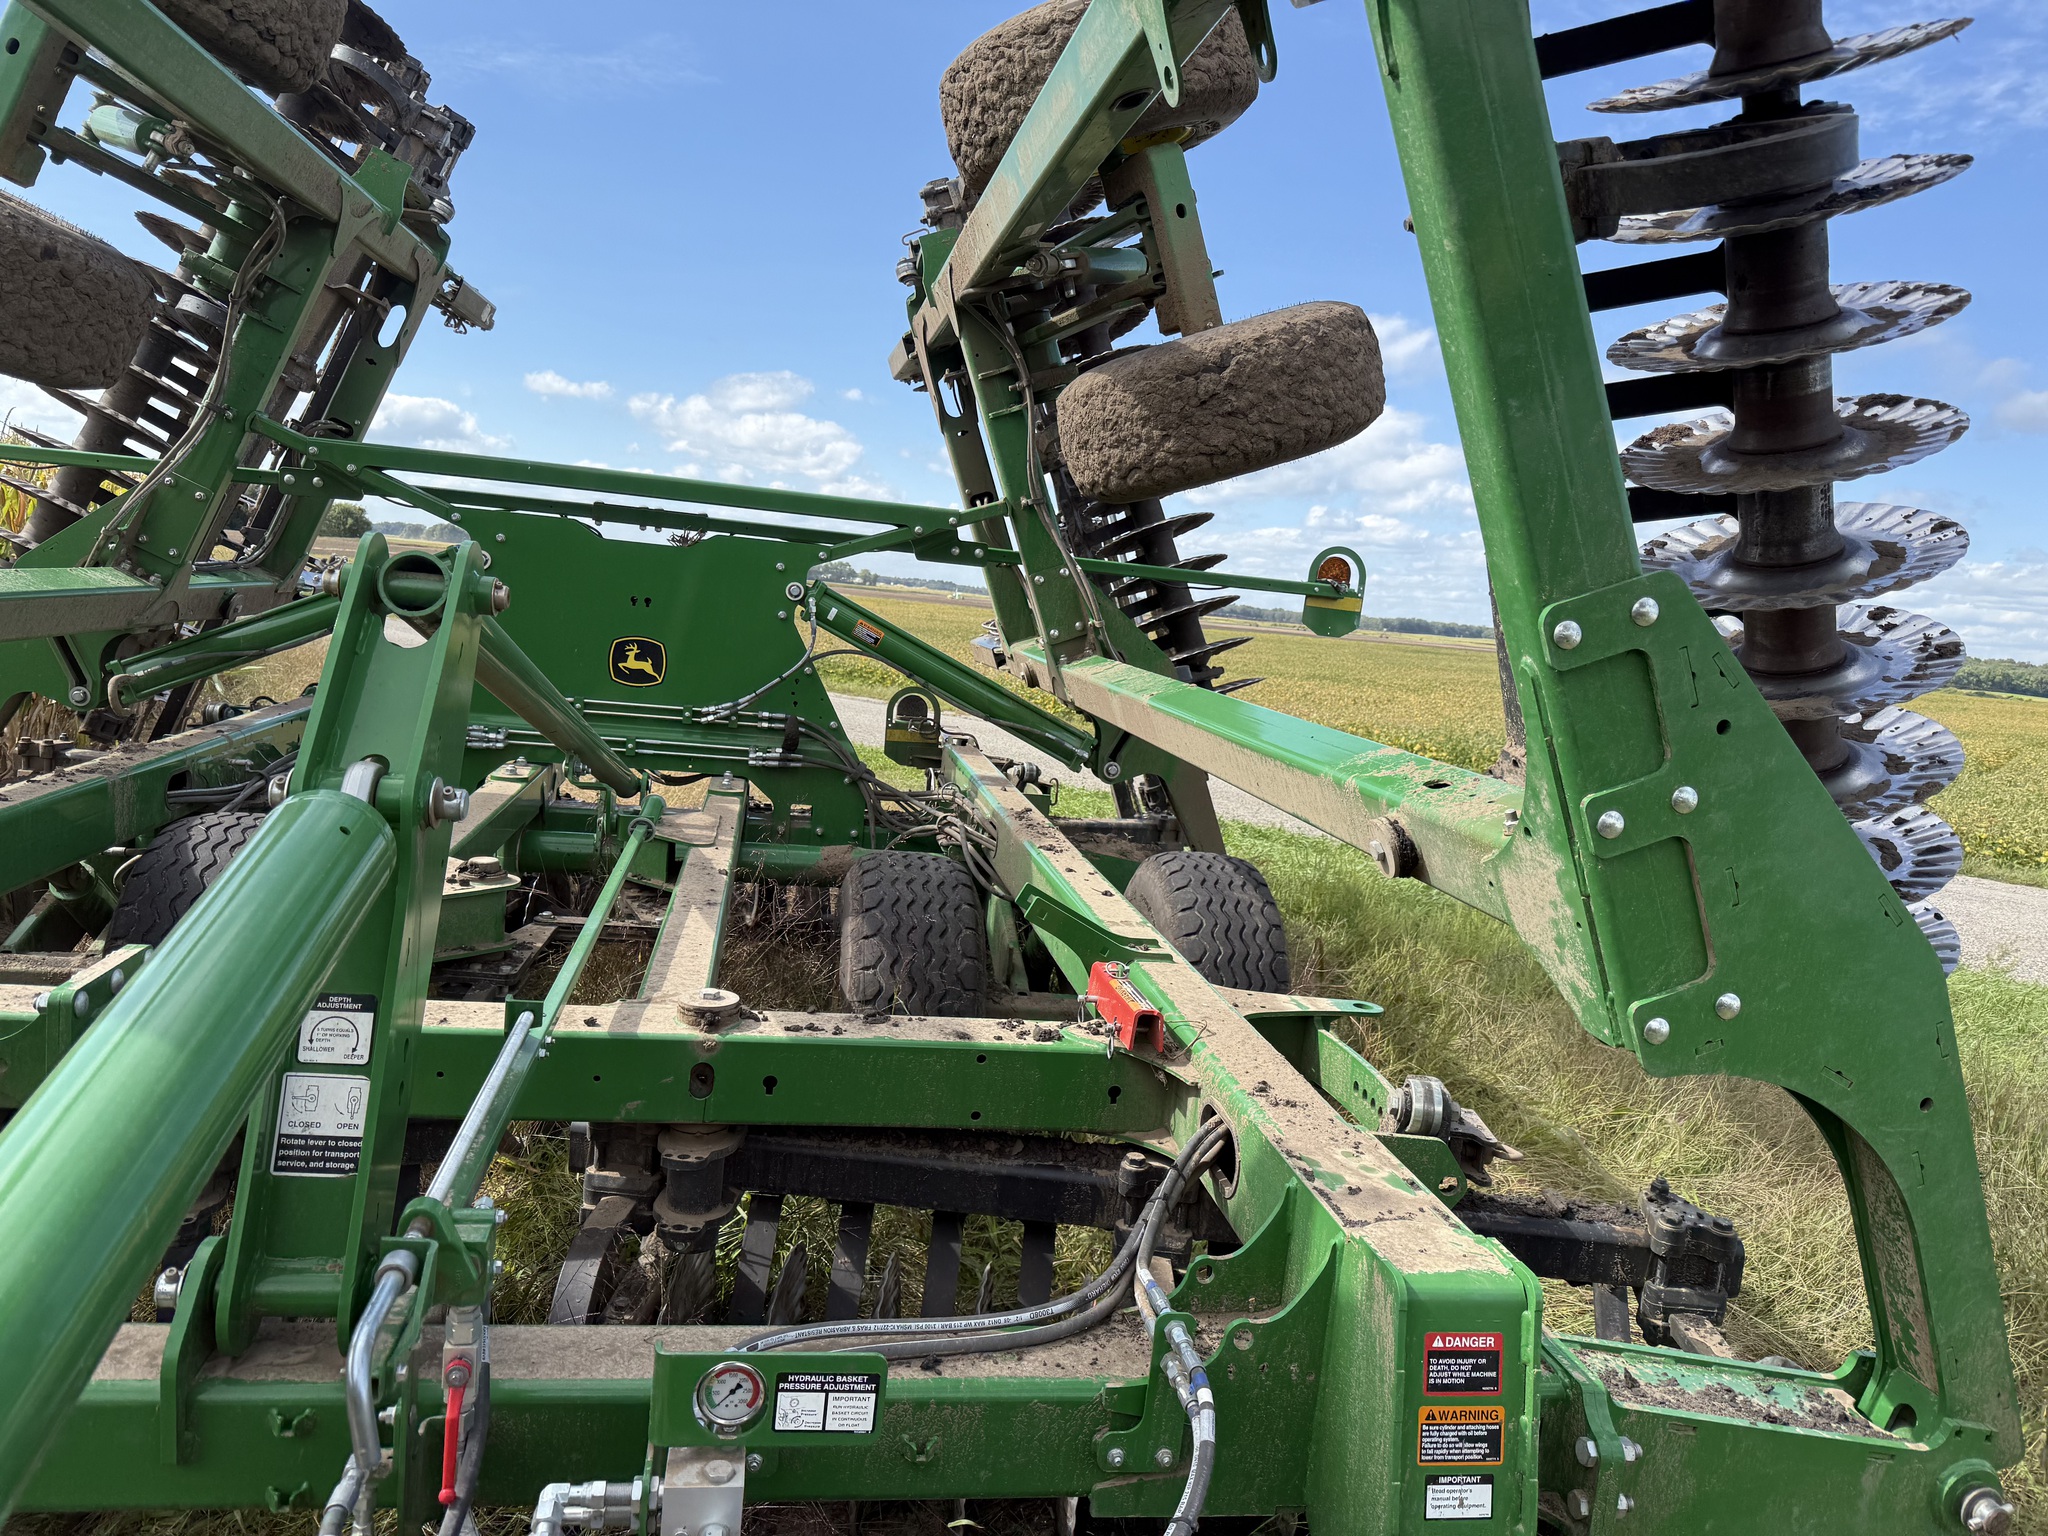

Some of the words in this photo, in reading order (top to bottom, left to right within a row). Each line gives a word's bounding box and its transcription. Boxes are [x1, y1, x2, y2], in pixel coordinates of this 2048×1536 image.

[1029, 1308, 1054, 1320] T3008D
[795, 1328, 822, 1338] RESISTANT
[1446, 1336, 1494, 1348] DANGER
[1438, 1410, 1499, 1420] WARNING
